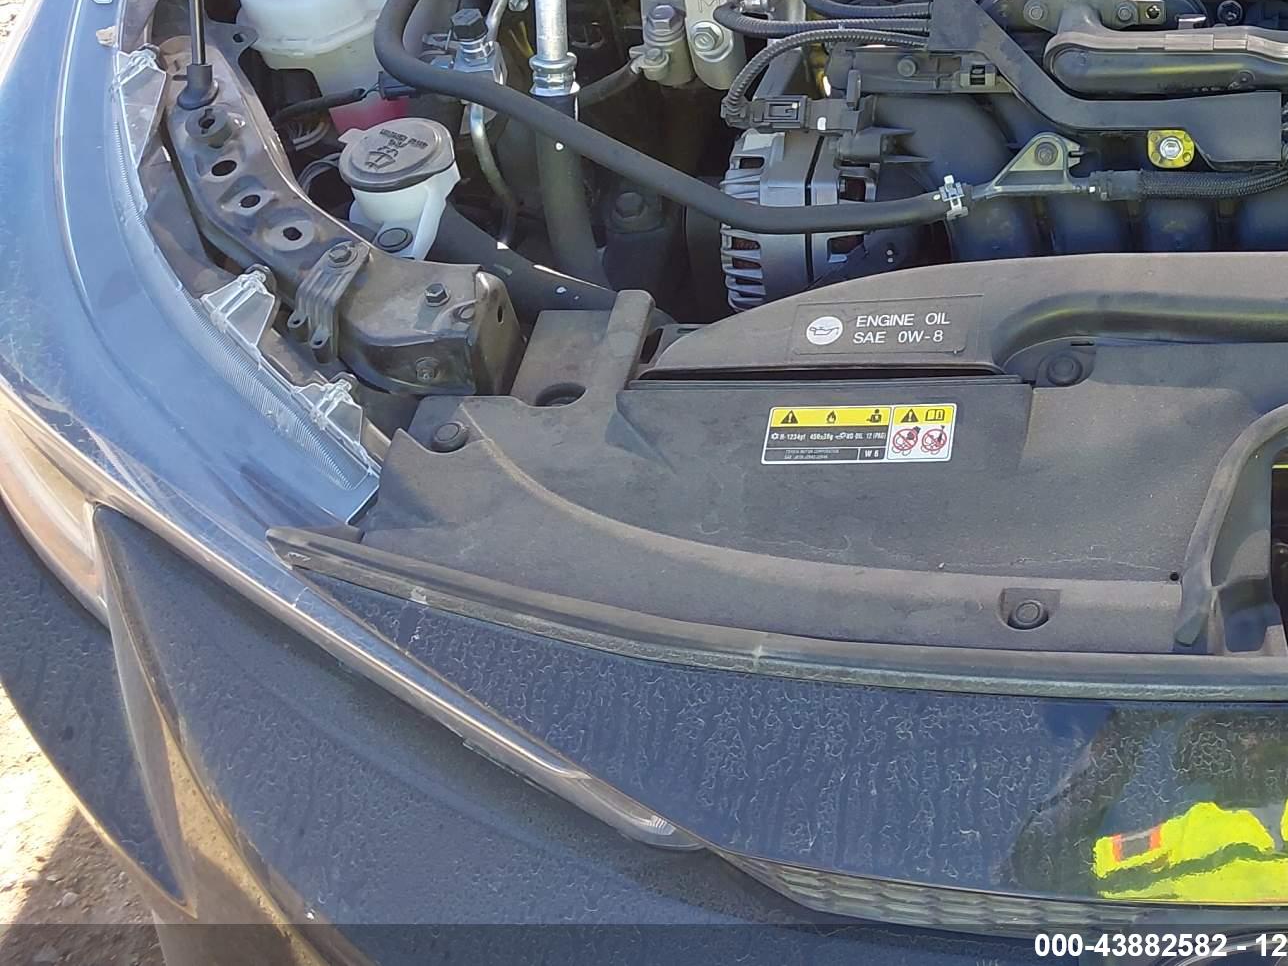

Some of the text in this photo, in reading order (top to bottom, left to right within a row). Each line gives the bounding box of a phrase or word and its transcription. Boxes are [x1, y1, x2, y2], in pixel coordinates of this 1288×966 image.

[856, 312, 951, 327] ENGINE OIL
[852, 330, 944, 344] SAE 0W-8
